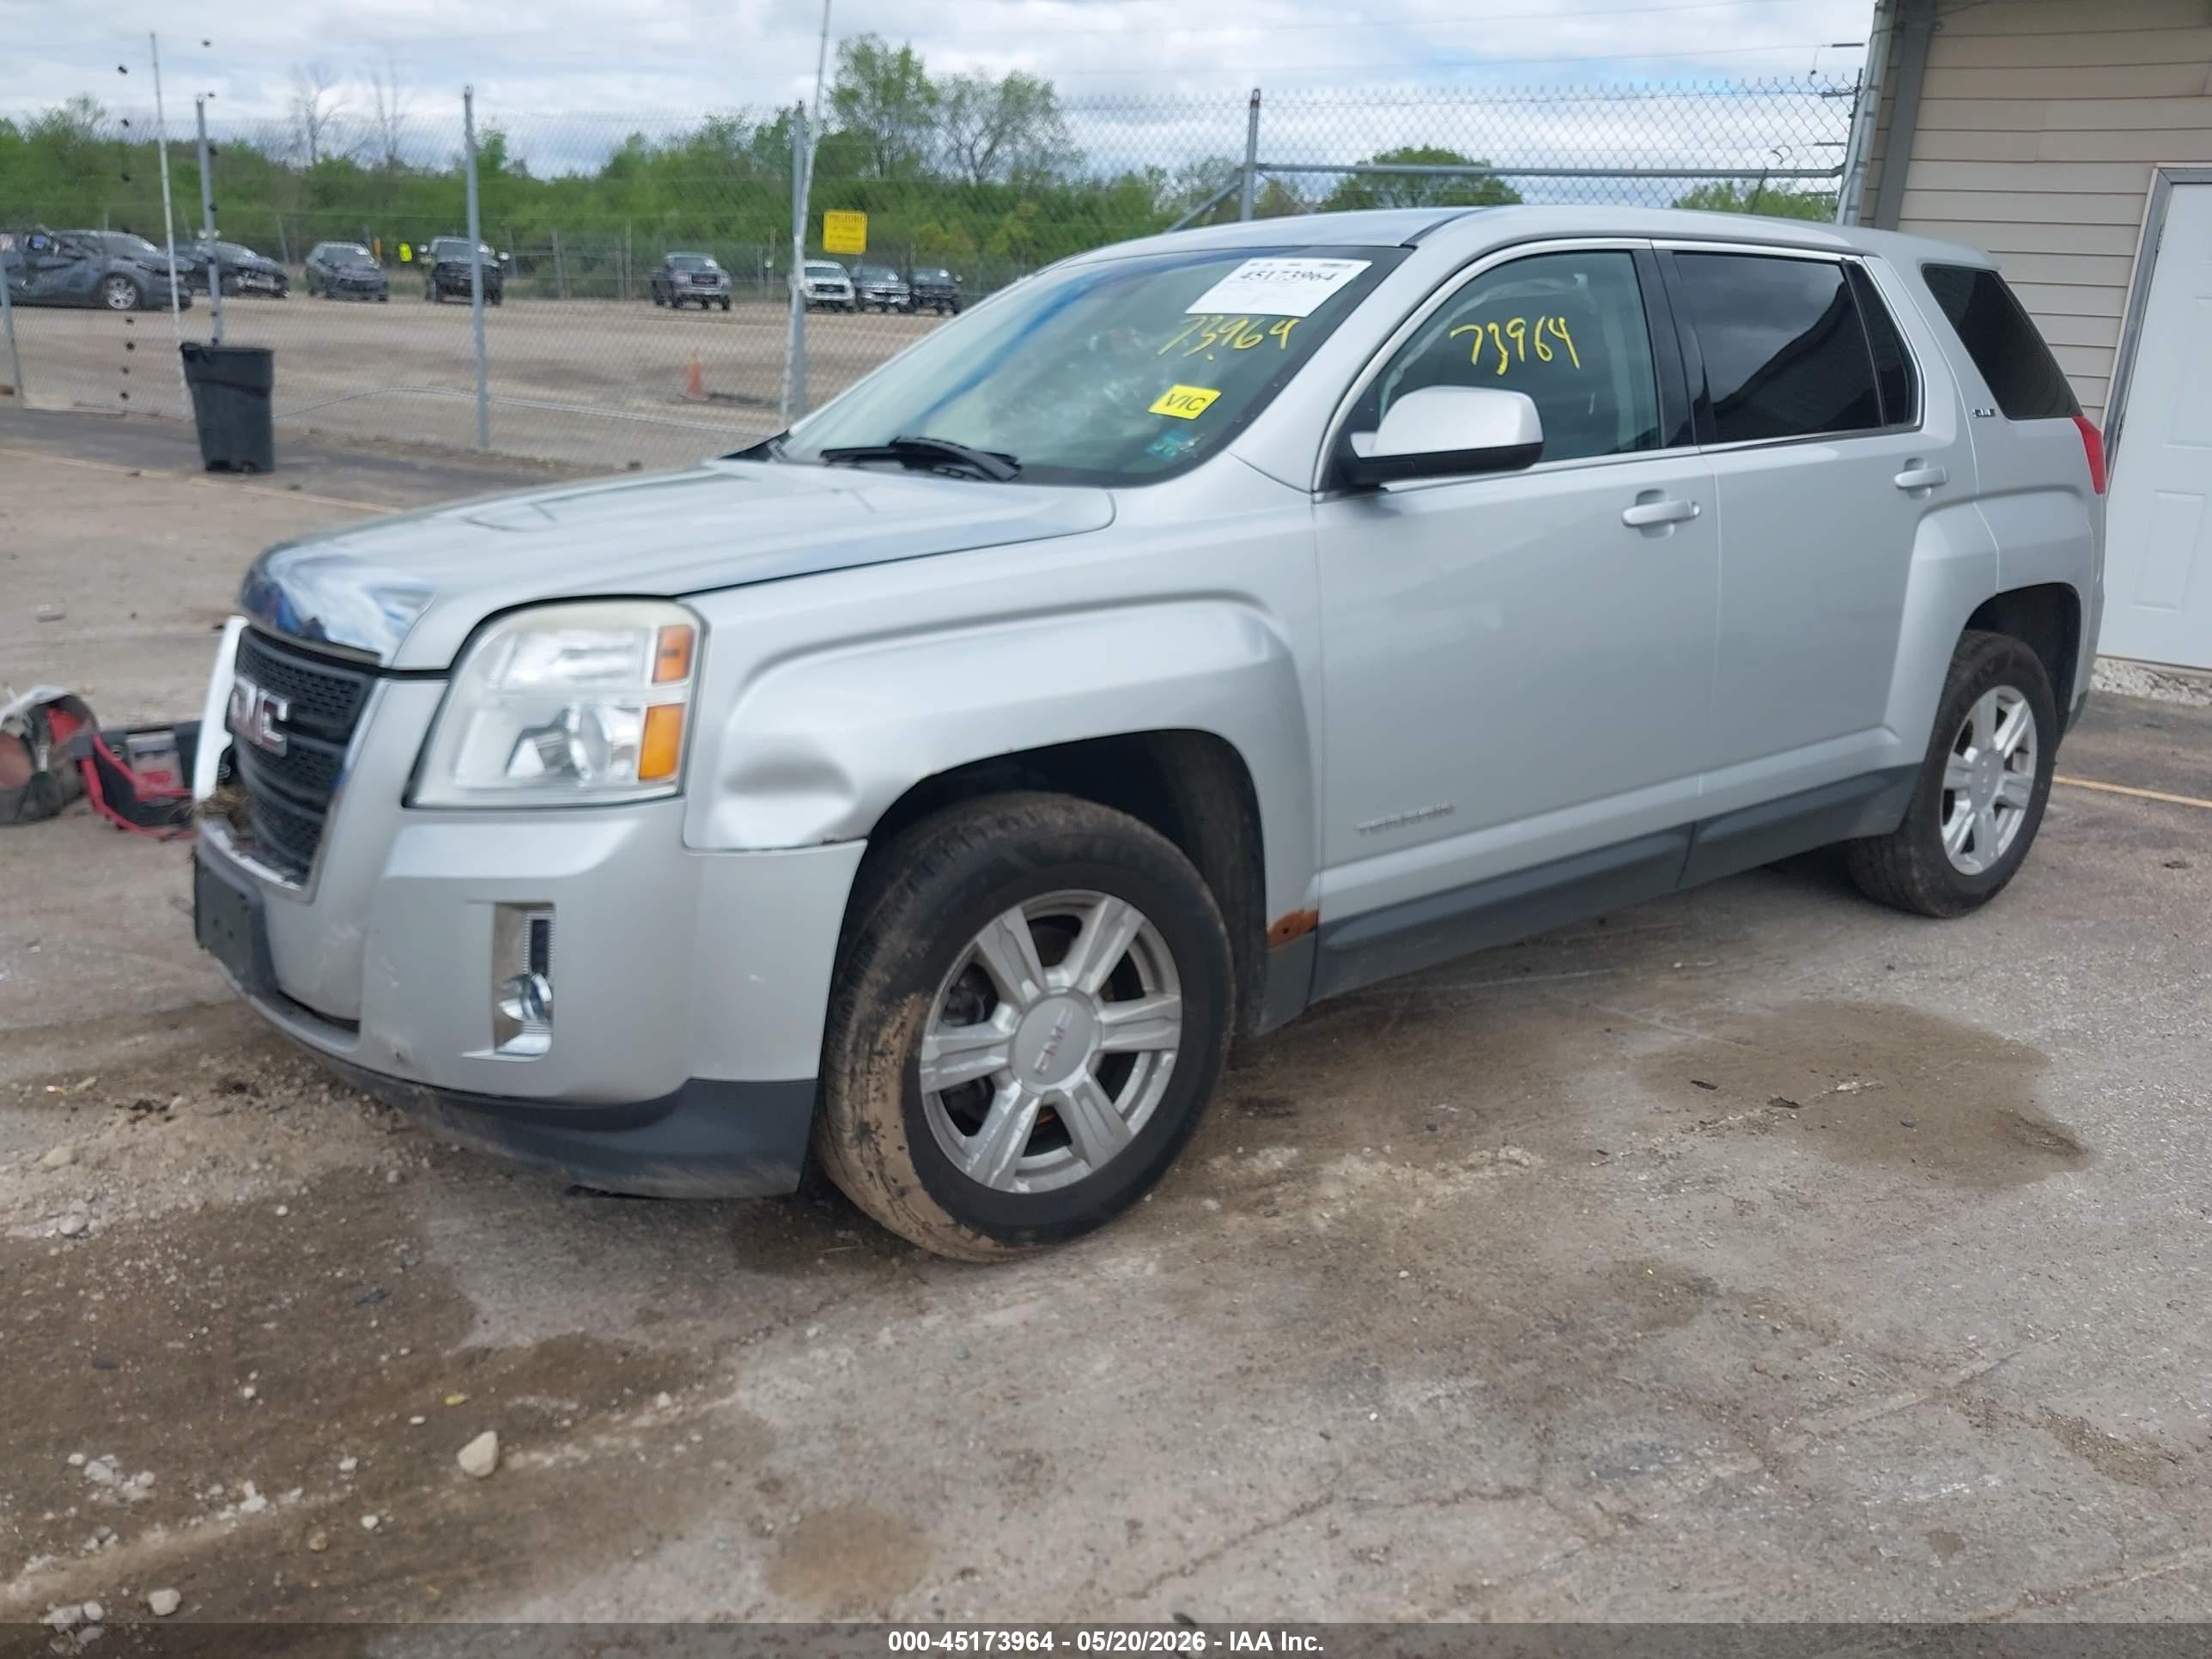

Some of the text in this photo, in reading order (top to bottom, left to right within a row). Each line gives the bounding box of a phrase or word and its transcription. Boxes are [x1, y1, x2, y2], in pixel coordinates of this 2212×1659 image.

[1158, 314, 1300, 358] 73964
[1449, 316, 1580, 375] 73964
[1167, 392, 1206, 411] VIC
